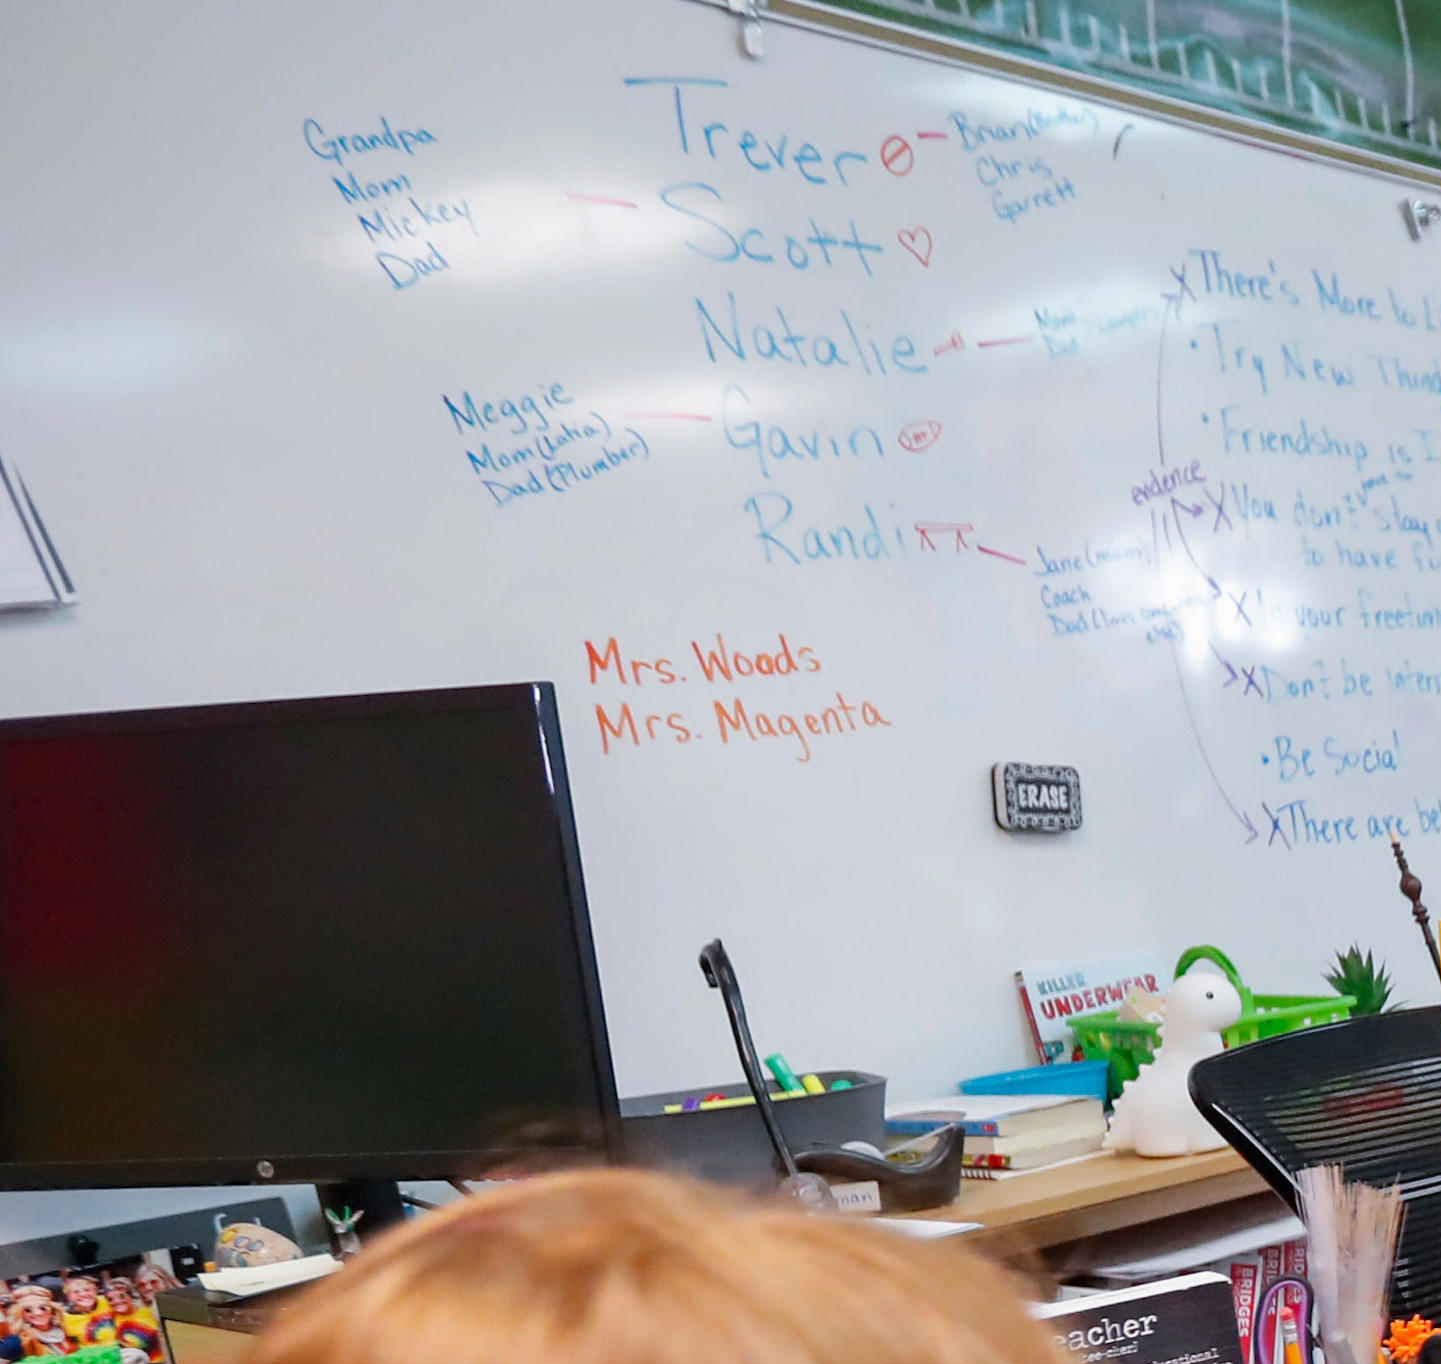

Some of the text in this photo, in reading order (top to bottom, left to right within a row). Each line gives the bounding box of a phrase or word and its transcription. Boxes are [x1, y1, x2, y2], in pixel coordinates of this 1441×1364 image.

[303, 115, 438, 166] Grandpa
[623, 79, 868, 185] Trever
[332, 171, 413, 205] Mom
[976, 153, 1053, 187] Chris
[357, 196, 479, 243] Mickey
[661, 182, 883, 277] Scott
[375, 241, 451, 290] Dad
[1189, 249, 1299, 307] There's
[1312, 270, 1381, 321] More
[1388, 288, 1417, 328] to
[694, 293, 929, 375] Natalie
[1196, 319, 1268, 394] Try
[1284, 344, 1354, 387] New
[442, 382, 574, 435] Meggie
[722, 385, 885, 476] Gavin
[1219, 406, 1370, 467] Friendship
[743, 490, 908, 564] Randi
[1304, 543, 1324, 569] to
[1335, 539, 1397, 571] have
[584, 633, 822, 687] Mrs. Woods
[594, 692, 892, 764] Mrs. Magenta
[1273, 729, 1400, 781] Be Social
[1018, 783, 1071, 811] ERASE
[1278, 800, 1359, 846] There
[1367, 813, 1410, 839] are
[1036, 972, 1087, 996] KILLER
[1238, 1267, 1254, 1337] BRIDGES
[1053, 1314, 1158, 1351] eacher
